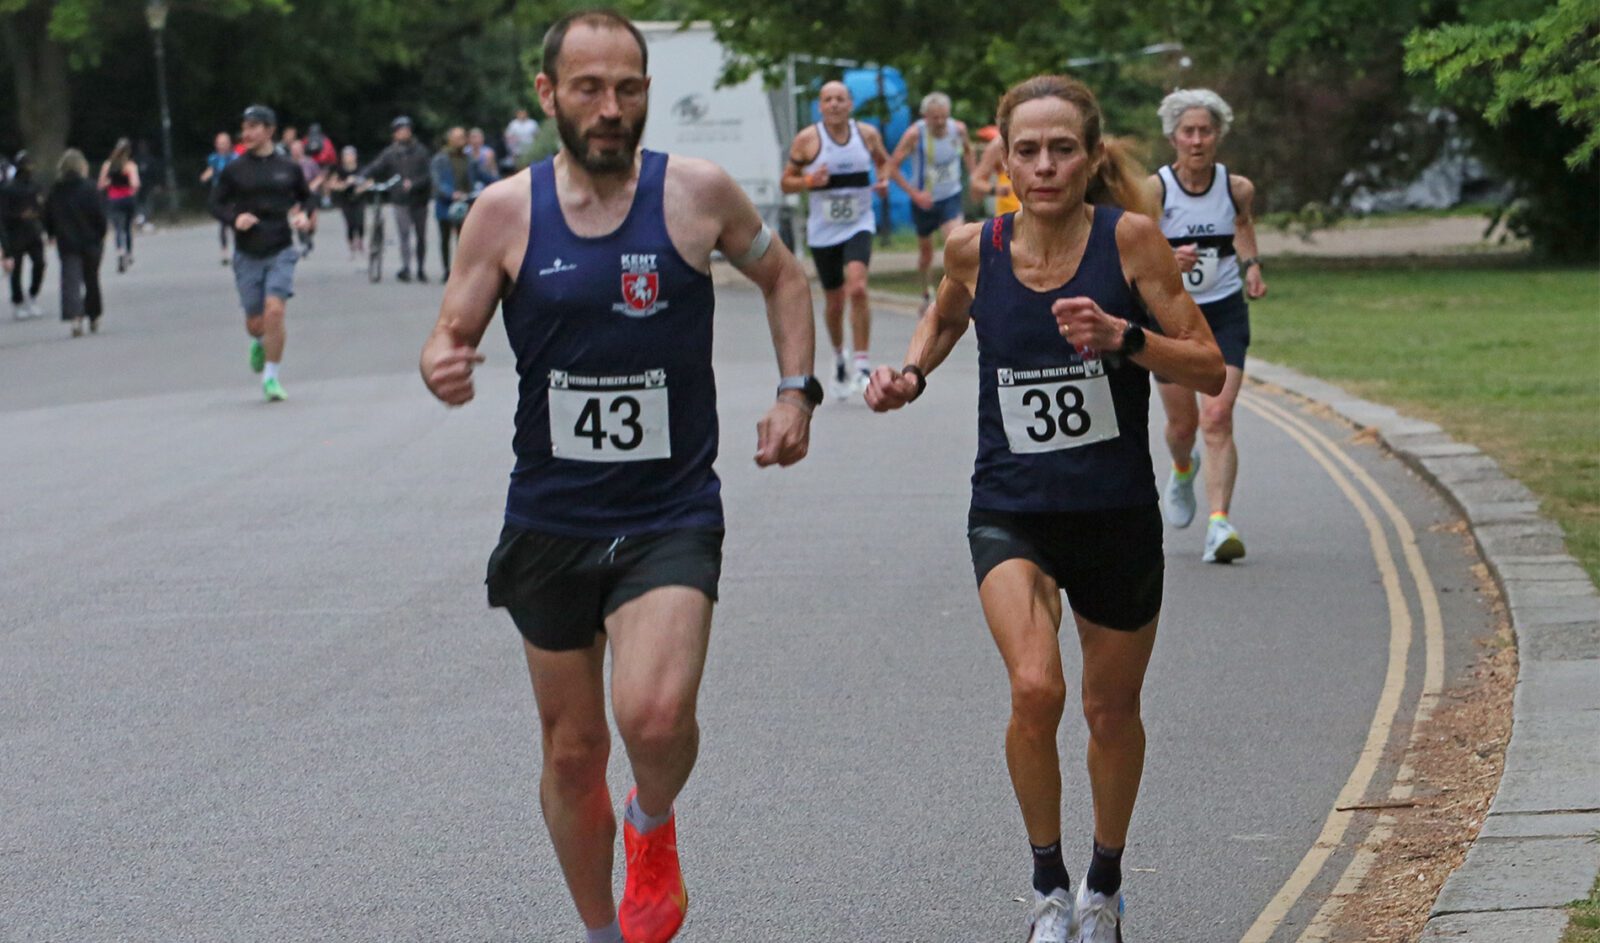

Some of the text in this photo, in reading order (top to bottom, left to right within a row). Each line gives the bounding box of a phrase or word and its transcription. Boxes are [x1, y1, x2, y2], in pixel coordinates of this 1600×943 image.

[1187, 223, 1215, 234] VAC
[621, 254, 657, 265] KENT
[1013, 365, 1084, 380] VETERANS ATHLETIC CLUB
[1022, 385, 1091, 443] 38
[574, 395, 643, 451] 43
